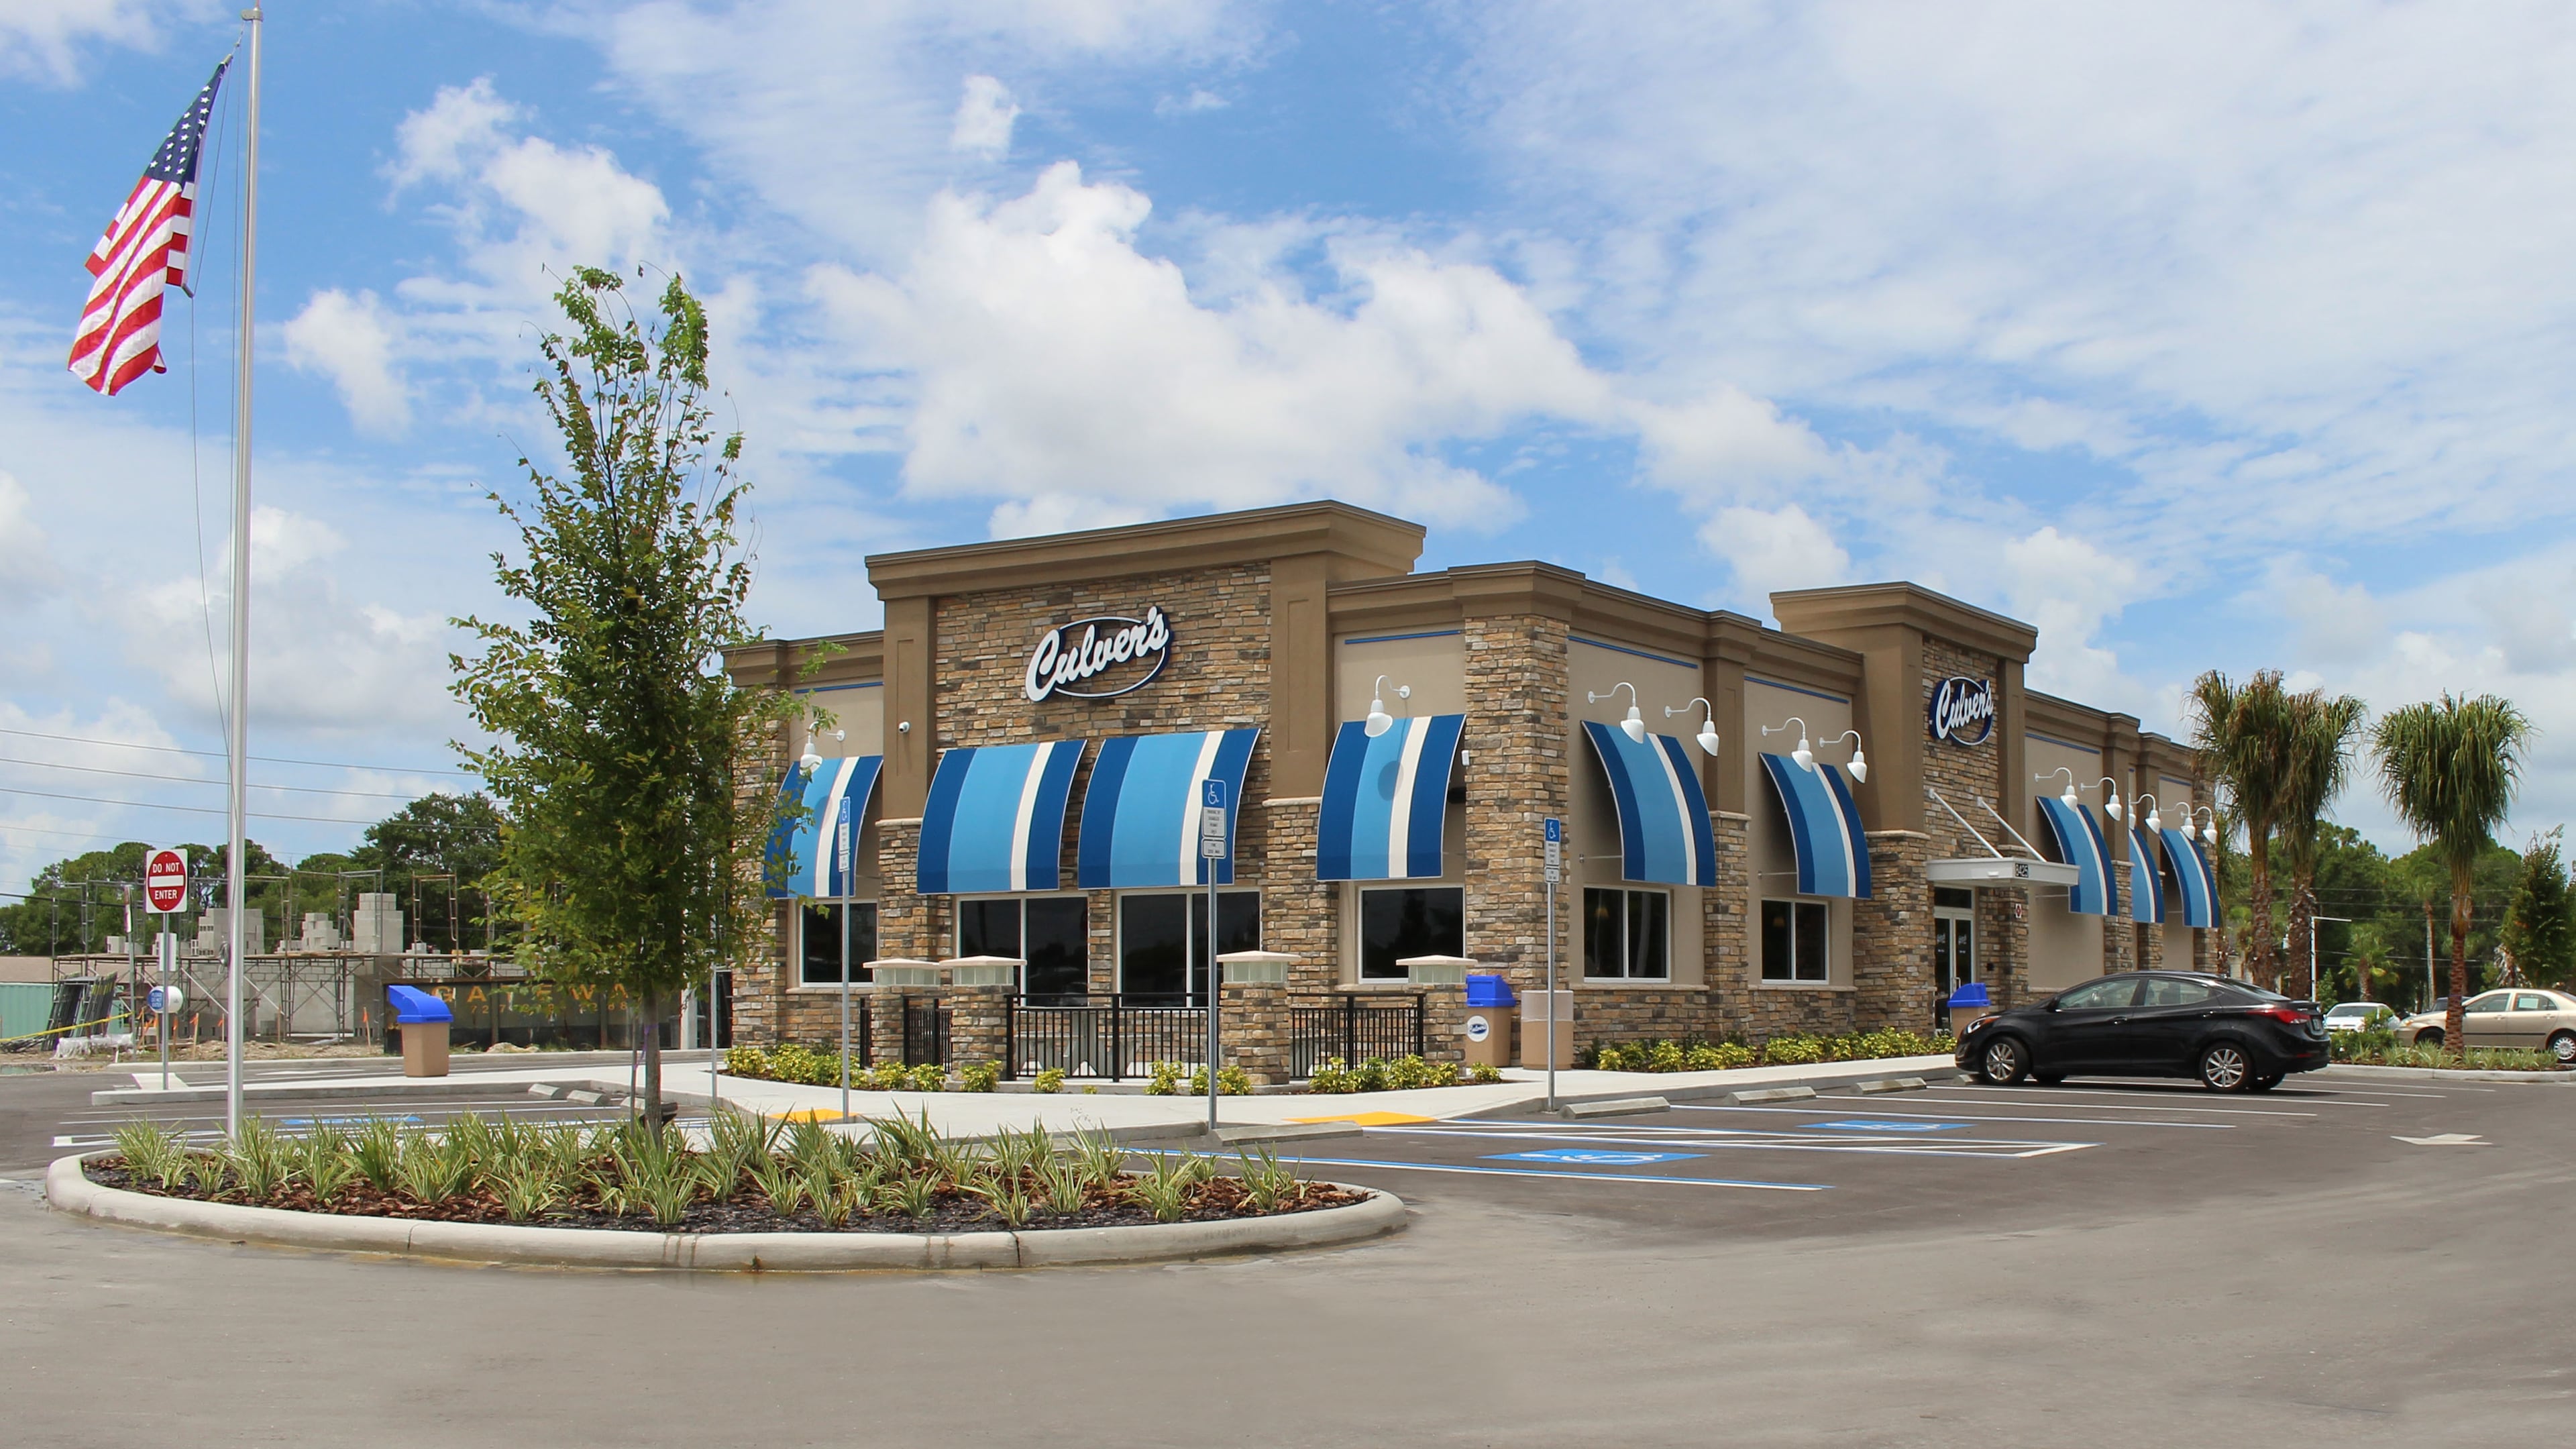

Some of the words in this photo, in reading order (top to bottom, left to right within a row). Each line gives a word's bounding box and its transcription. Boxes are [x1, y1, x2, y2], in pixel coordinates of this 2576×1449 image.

[1025, 606, 1169, 702] Culver's
[1935, 679, 1994, 740] Culver's
[152, 863, 162, 873] DO
[166, 862, 180, 873] NOT
[154, 889, 178, 900] ENTER
[431, 983, 629, 1003] GATEWA
